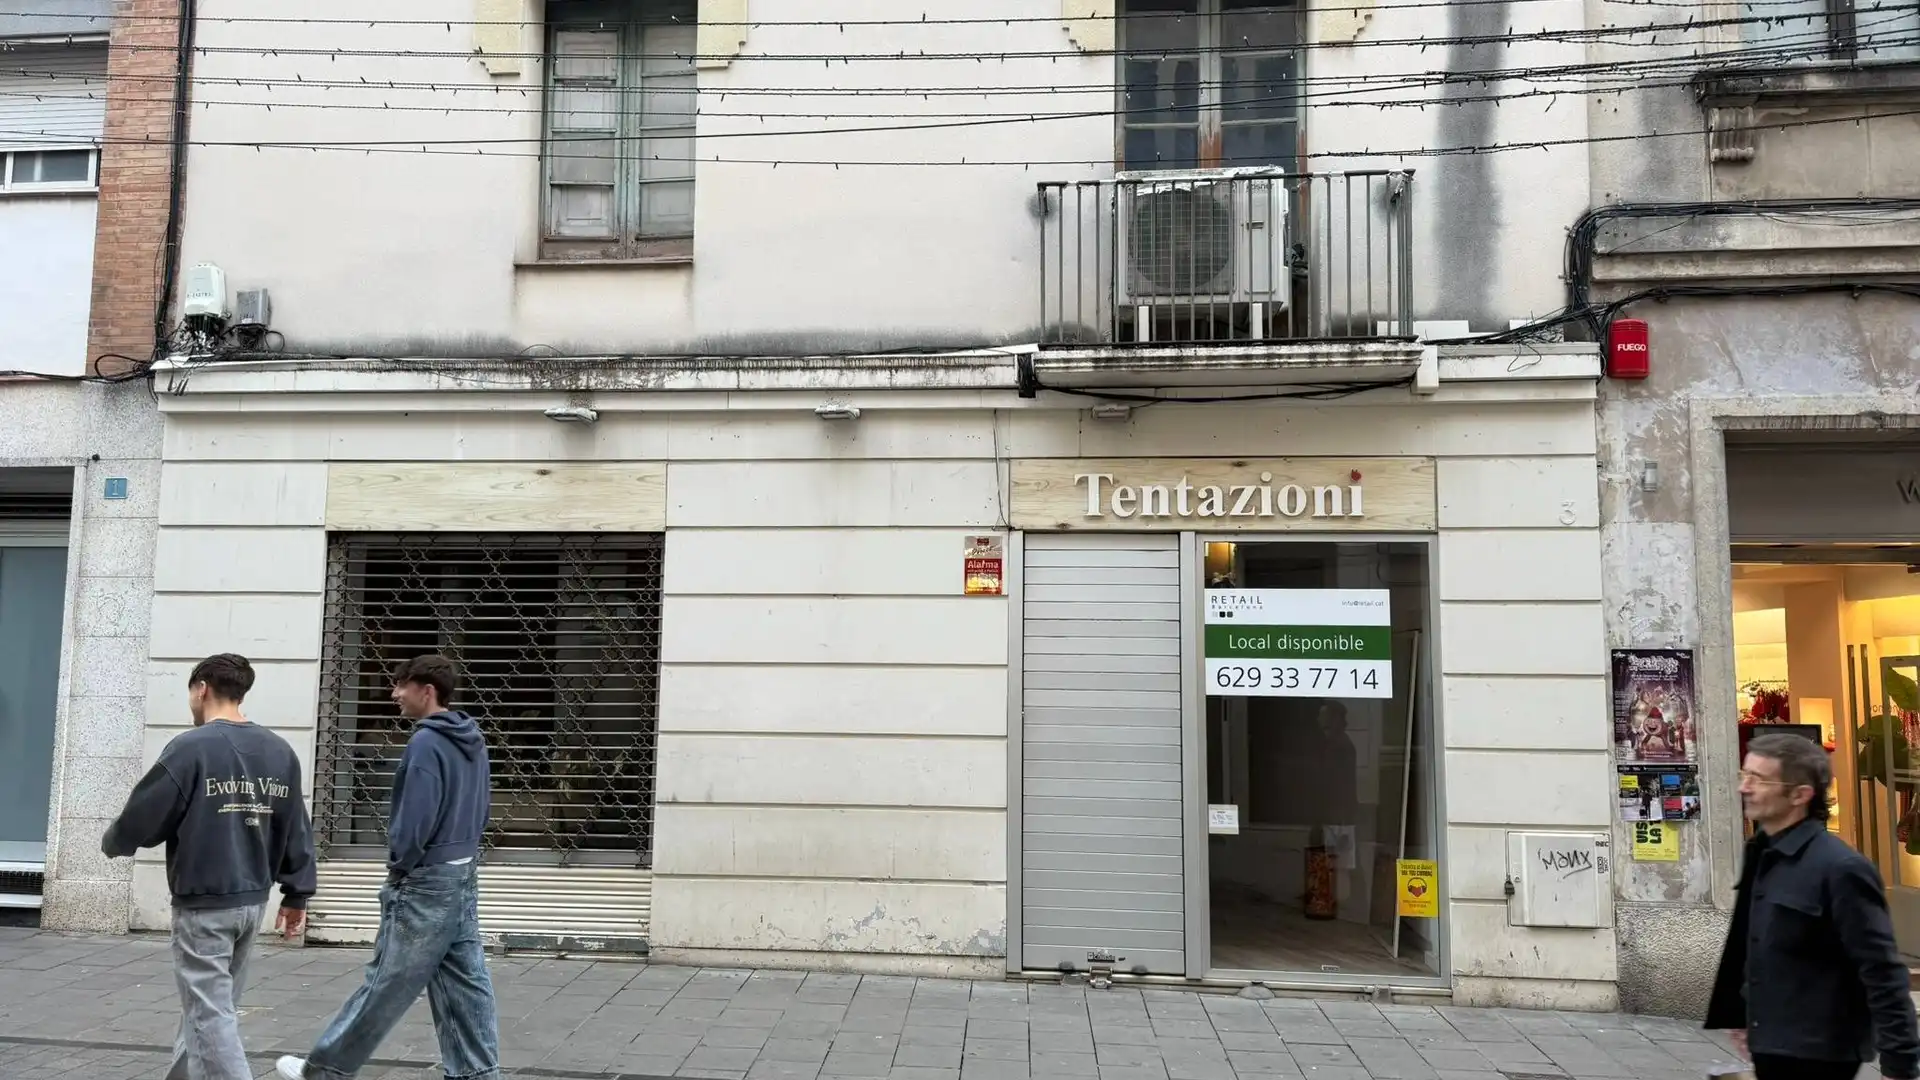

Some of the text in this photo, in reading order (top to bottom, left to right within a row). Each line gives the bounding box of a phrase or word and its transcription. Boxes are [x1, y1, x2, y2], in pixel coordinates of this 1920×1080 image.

[1617, 343, 1647, 352] FUEGO
[1074, 470, 1365, 517] Tentazioni
[1558, 500, 1576, 526] 3
[967, 560, 999, 569] Alarma
[1211, 595, 1263, 605] RETAIL
[1229, 634, 1364, 654] Local disponible
[1216, 666, 1380, 690] 629 33 77 14
